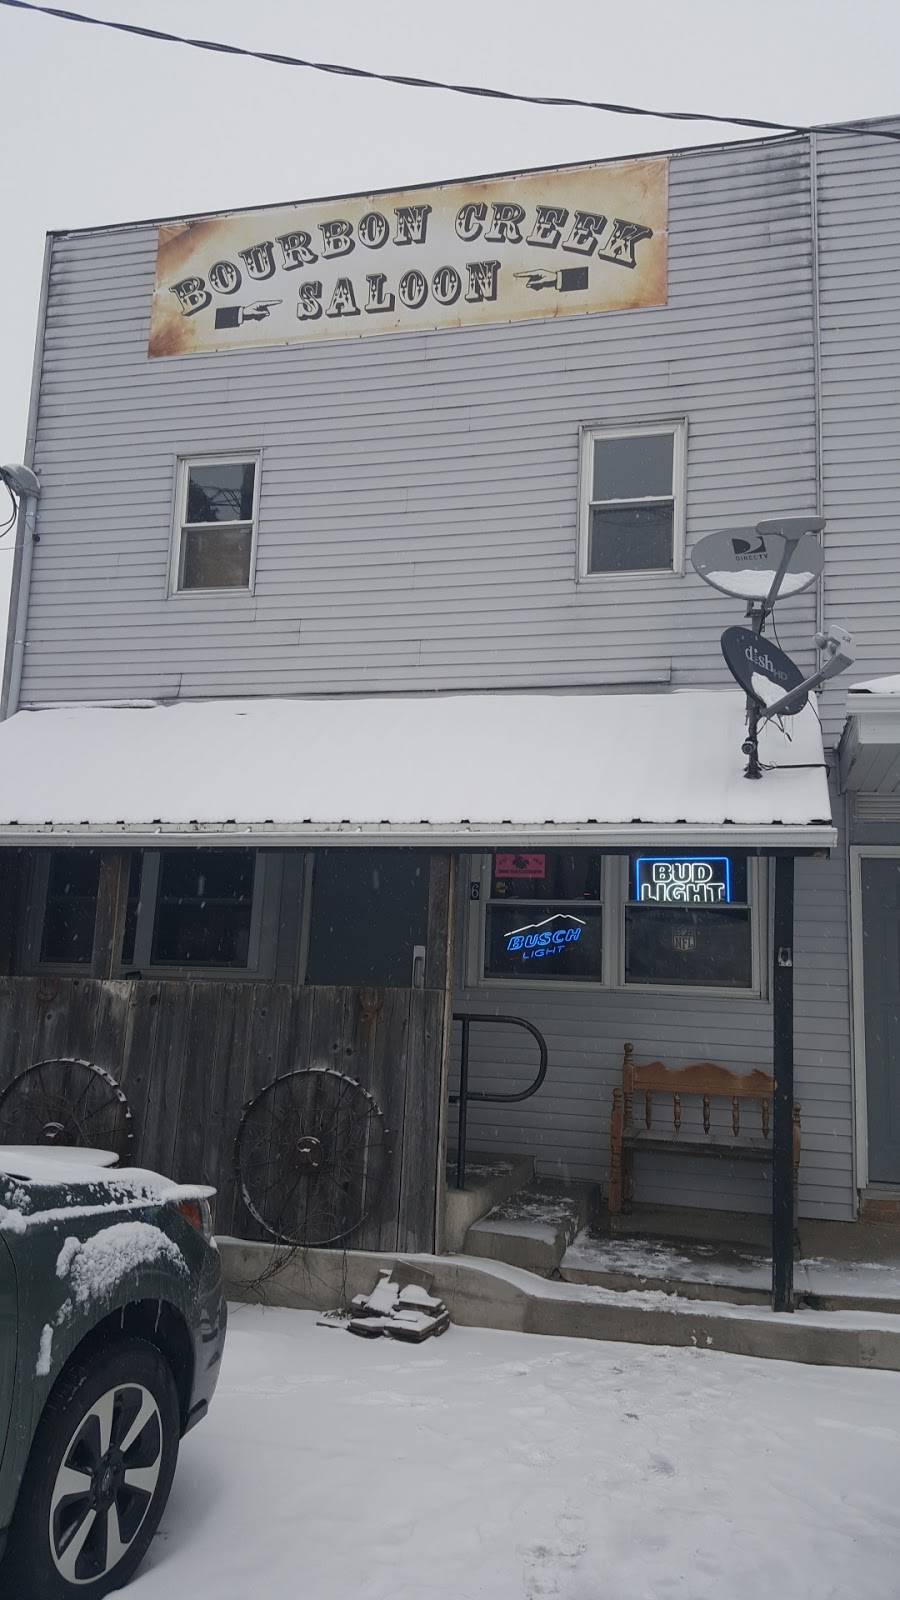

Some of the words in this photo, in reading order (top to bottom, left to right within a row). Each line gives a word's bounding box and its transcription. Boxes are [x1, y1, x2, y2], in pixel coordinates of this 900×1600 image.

[169, 204, 432, 316] BOURBON
[454, 202, 653, 269] CREEK
[296, 259, 501, 321] SALOON
[745, 645, 774, 673] dish
[652, 862, 713, 883] BUD
[471, 883, 480, 898] 6
[641, 882, 725, 902] LIGHT
[507, 927, 581, 951] BUSCH
[522, 945, 565, 960] LIGHT
